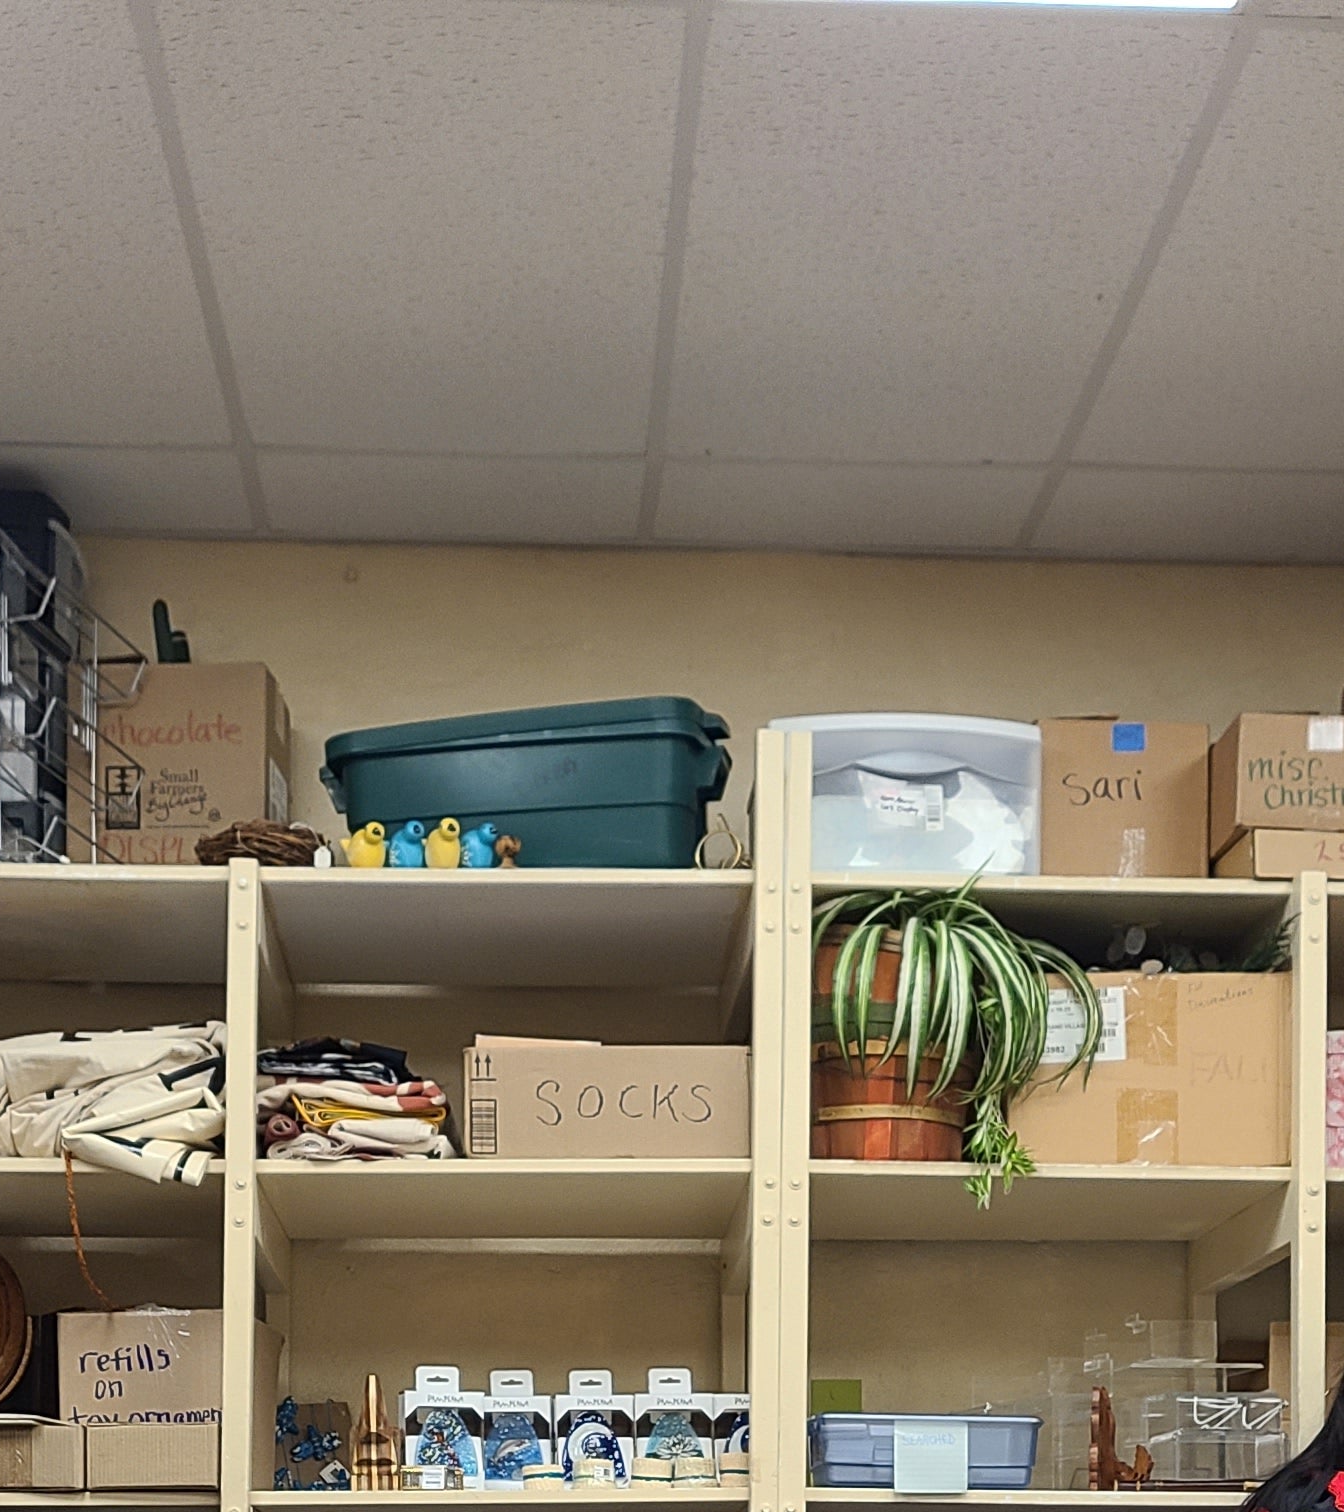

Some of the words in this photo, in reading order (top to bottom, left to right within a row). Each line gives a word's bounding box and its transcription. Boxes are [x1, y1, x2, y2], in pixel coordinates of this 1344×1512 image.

[160, 768, 199, 783] Small
[1061, 771, 1145, 806] Sari
[535, 1080, 713, 1126] SOCKS
[79, 1343, 171, 1373] refills
[94, 1379, 124, 1400] on
